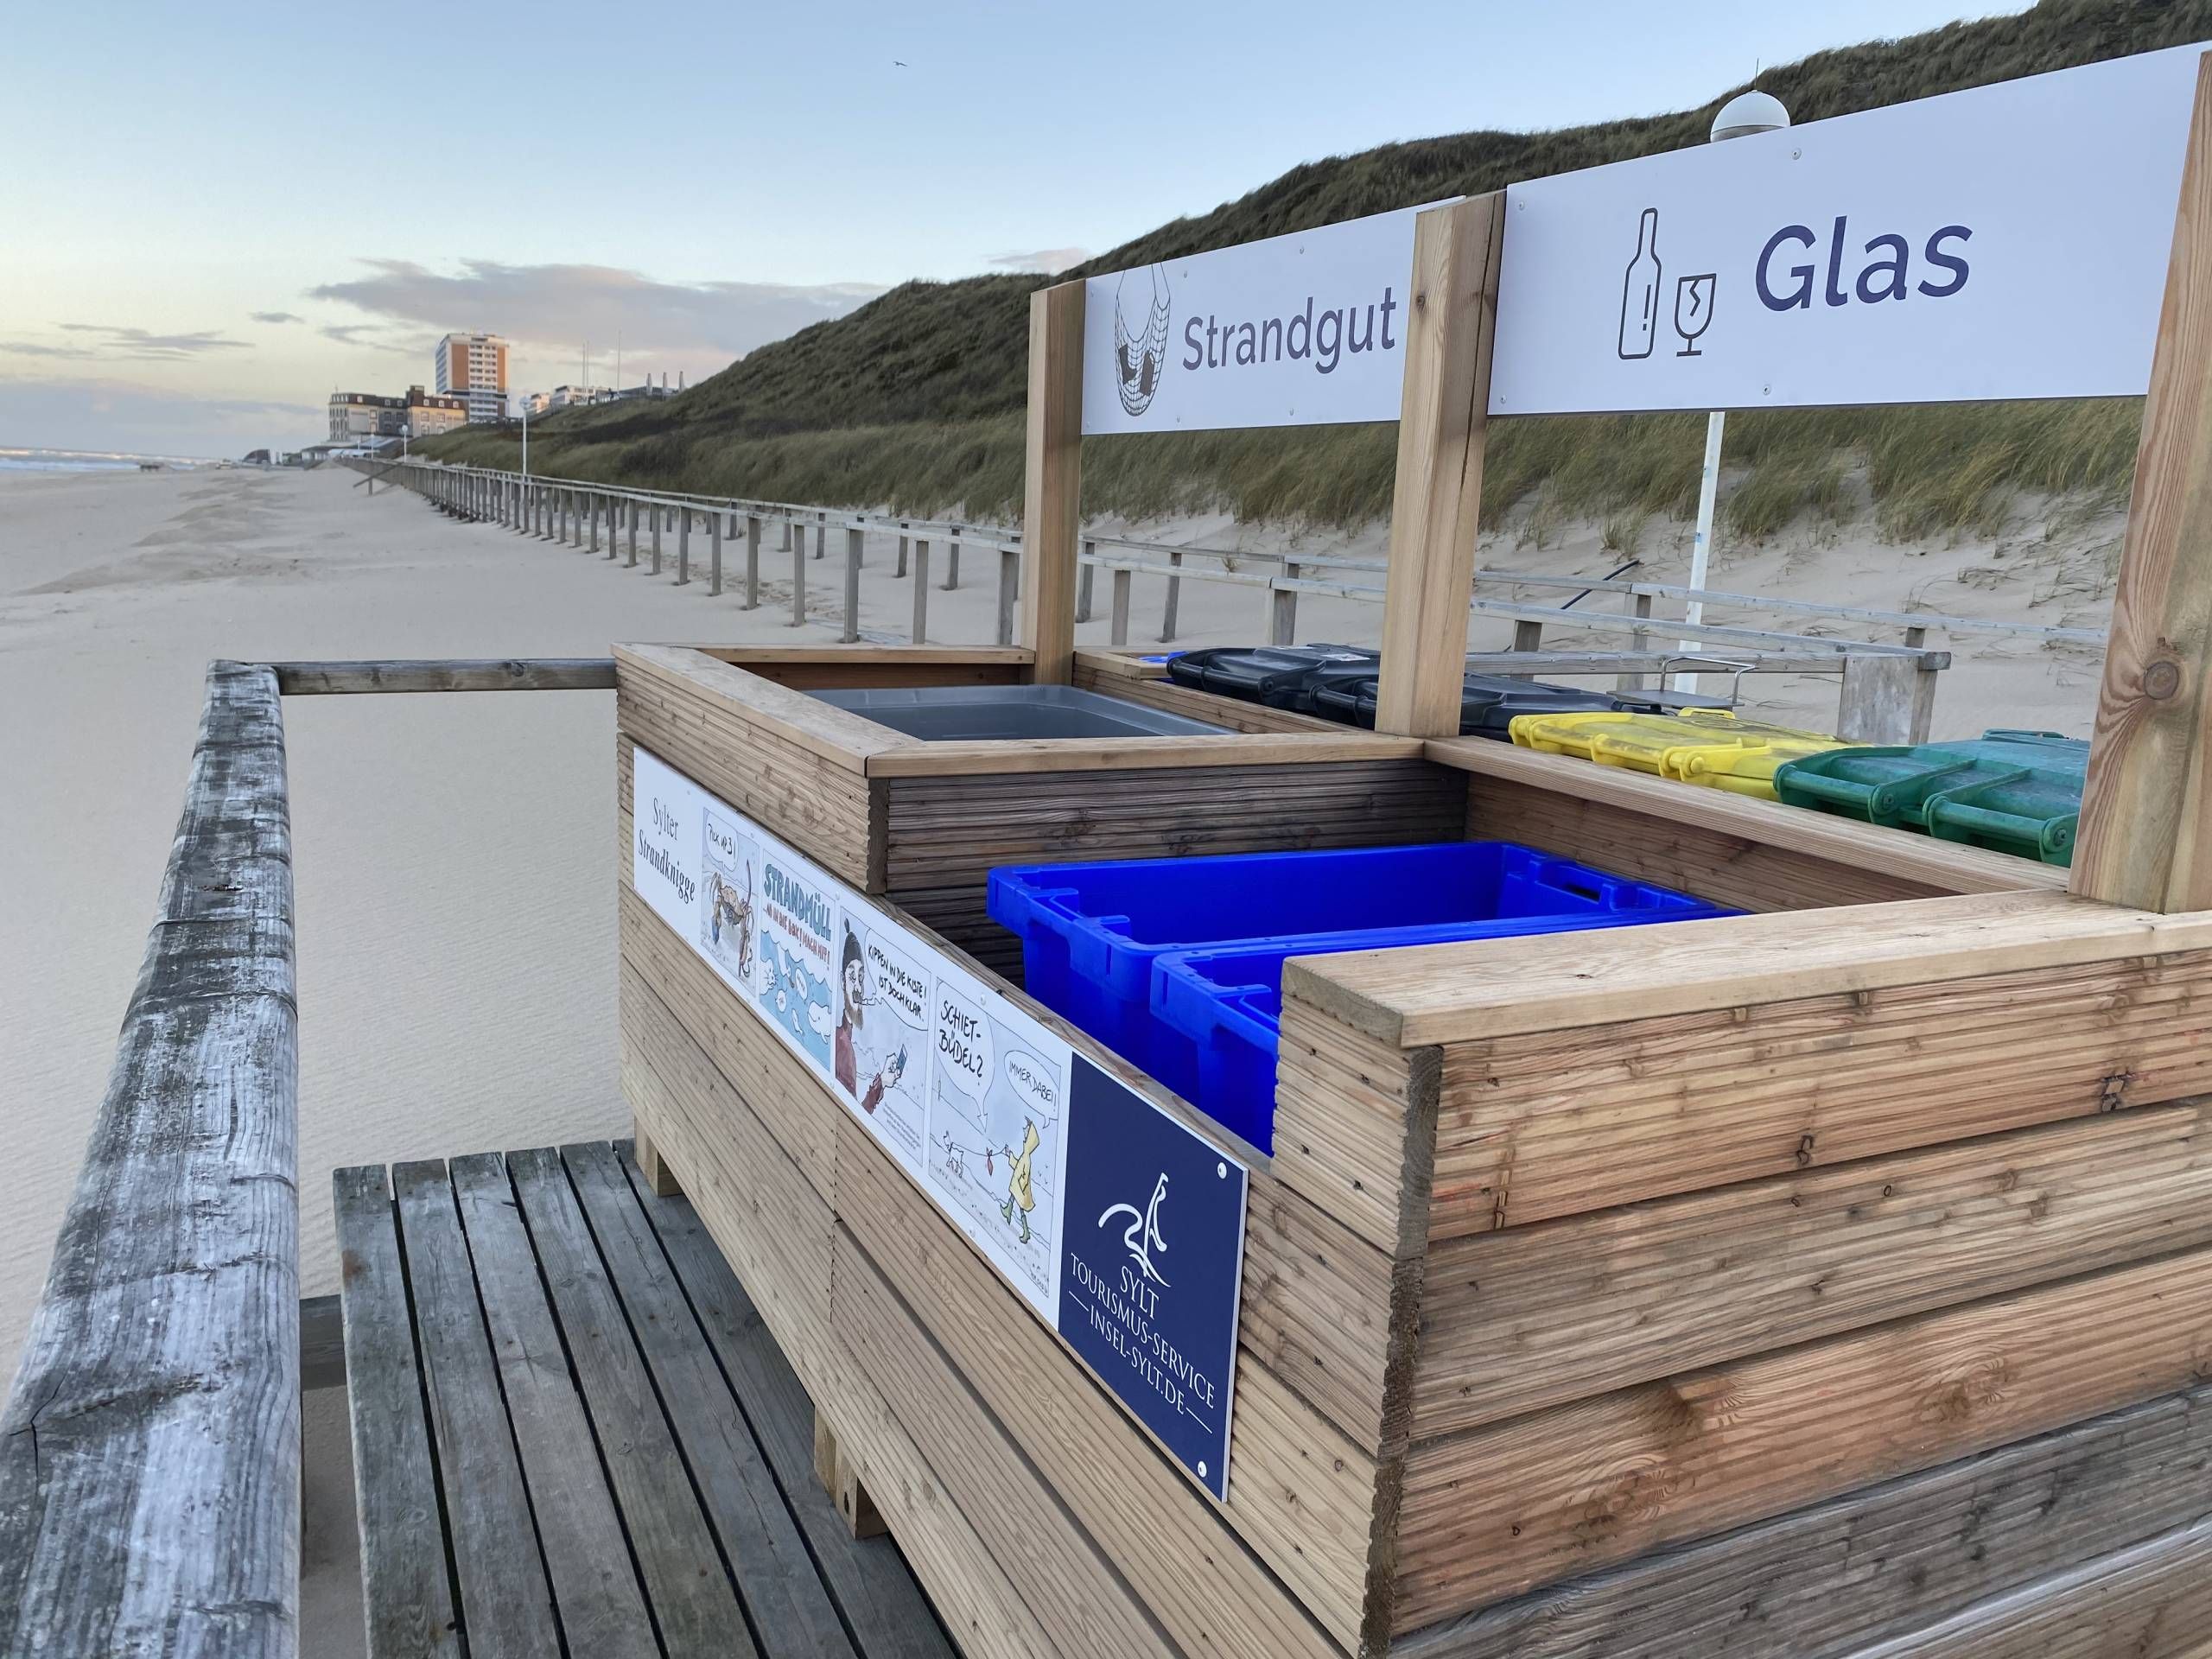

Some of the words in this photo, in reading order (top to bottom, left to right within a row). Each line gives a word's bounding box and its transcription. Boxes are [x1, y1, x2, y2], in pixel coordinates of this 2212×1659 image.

[1755, 215, 1974, 312] Glas
[1182, 286, 1396, 374] Strandgut
[653, 798, 678, 841] Sylter
[639, 829, 695, 905] Strandknigge
[764, 863, 831, 942] STRANDMÜLL
[868, 944, 889, 971] KIPPEN
[889, 961, 896, 977] IN
[896, 965, 906, 986] DIE
[879, 974, 888, 991] IST
[940, 1000, 981, 1043] SCHIET-
[938, 1028, 983, 1086] BÜDEL?
[1008, 1060, 1032, 1088] IMMER
[1120, 1265, 1160, 1320] SYLT
[1071, 1252, 1215, 1409] TOURISMUS-SERVICE
